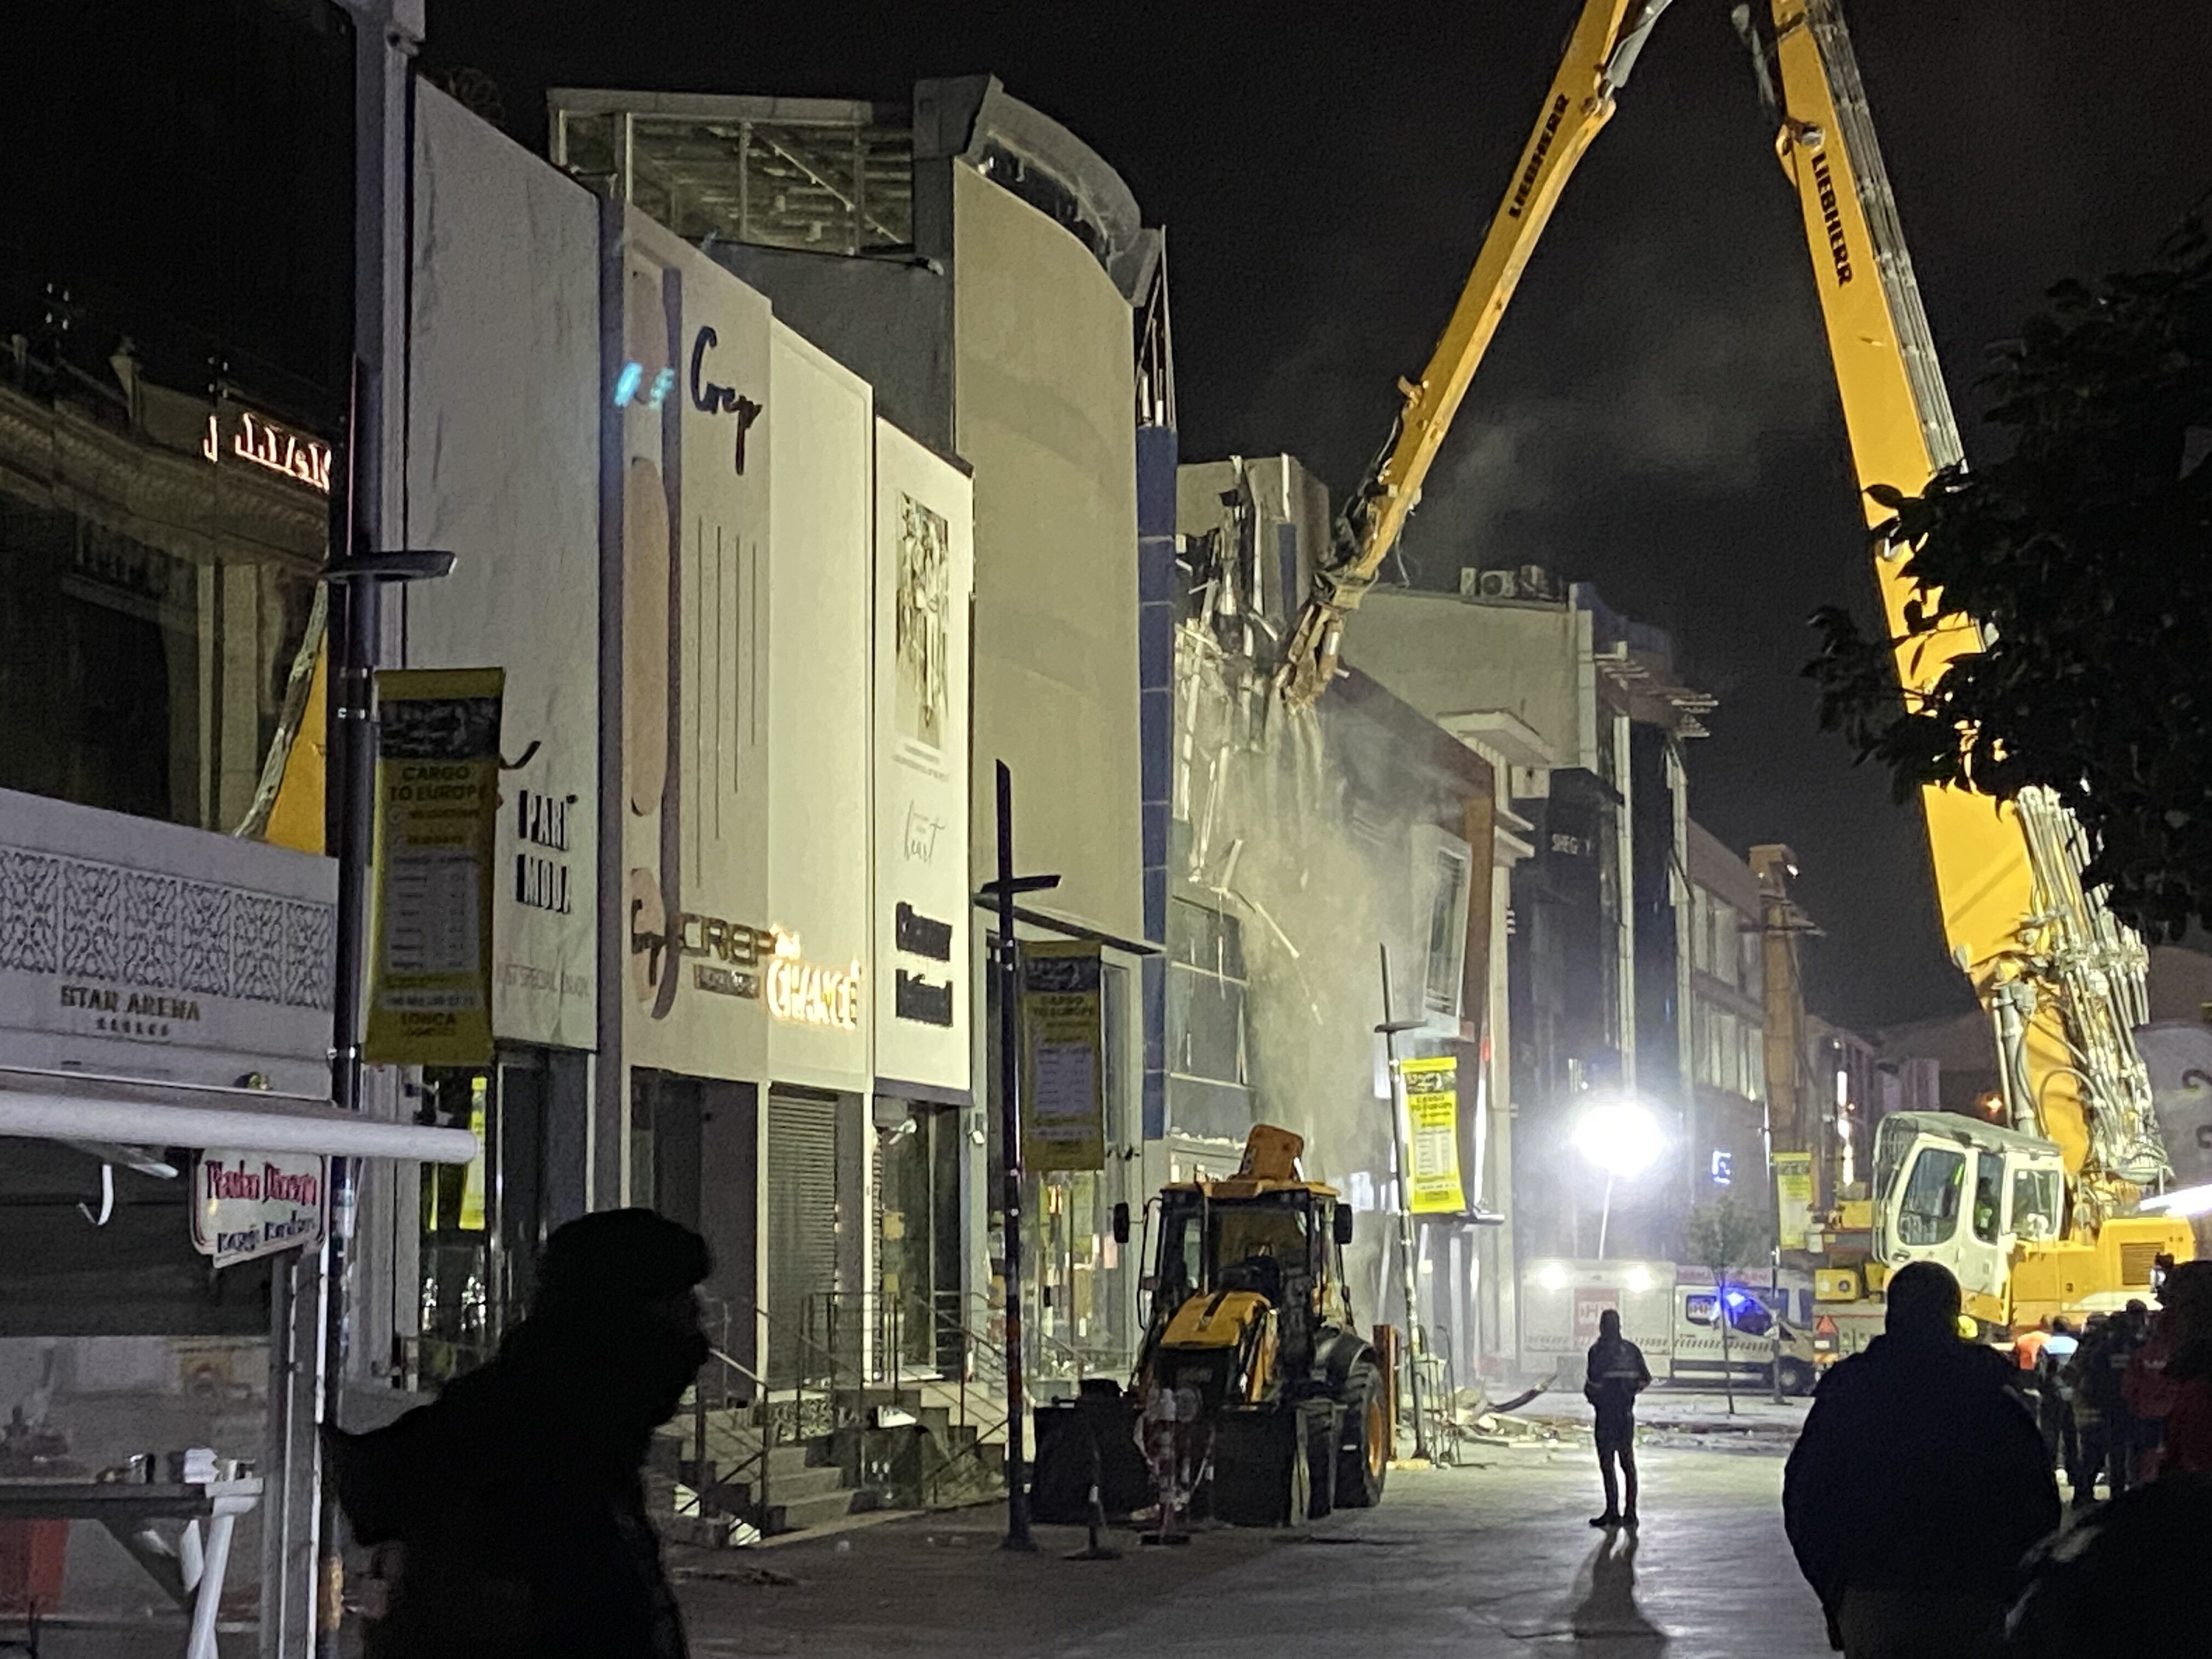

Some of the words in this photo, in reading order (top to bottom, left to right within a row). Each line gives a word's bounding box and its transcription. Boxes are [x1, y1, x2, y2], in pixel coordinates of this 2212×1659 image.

[1509, 93, 1571, 219] LIEBHERR
[1810, 151, 1853, 289] LIEBHERR
[390, 786, 412, 802] TO
[402, 766, 469, 781] CARGO
